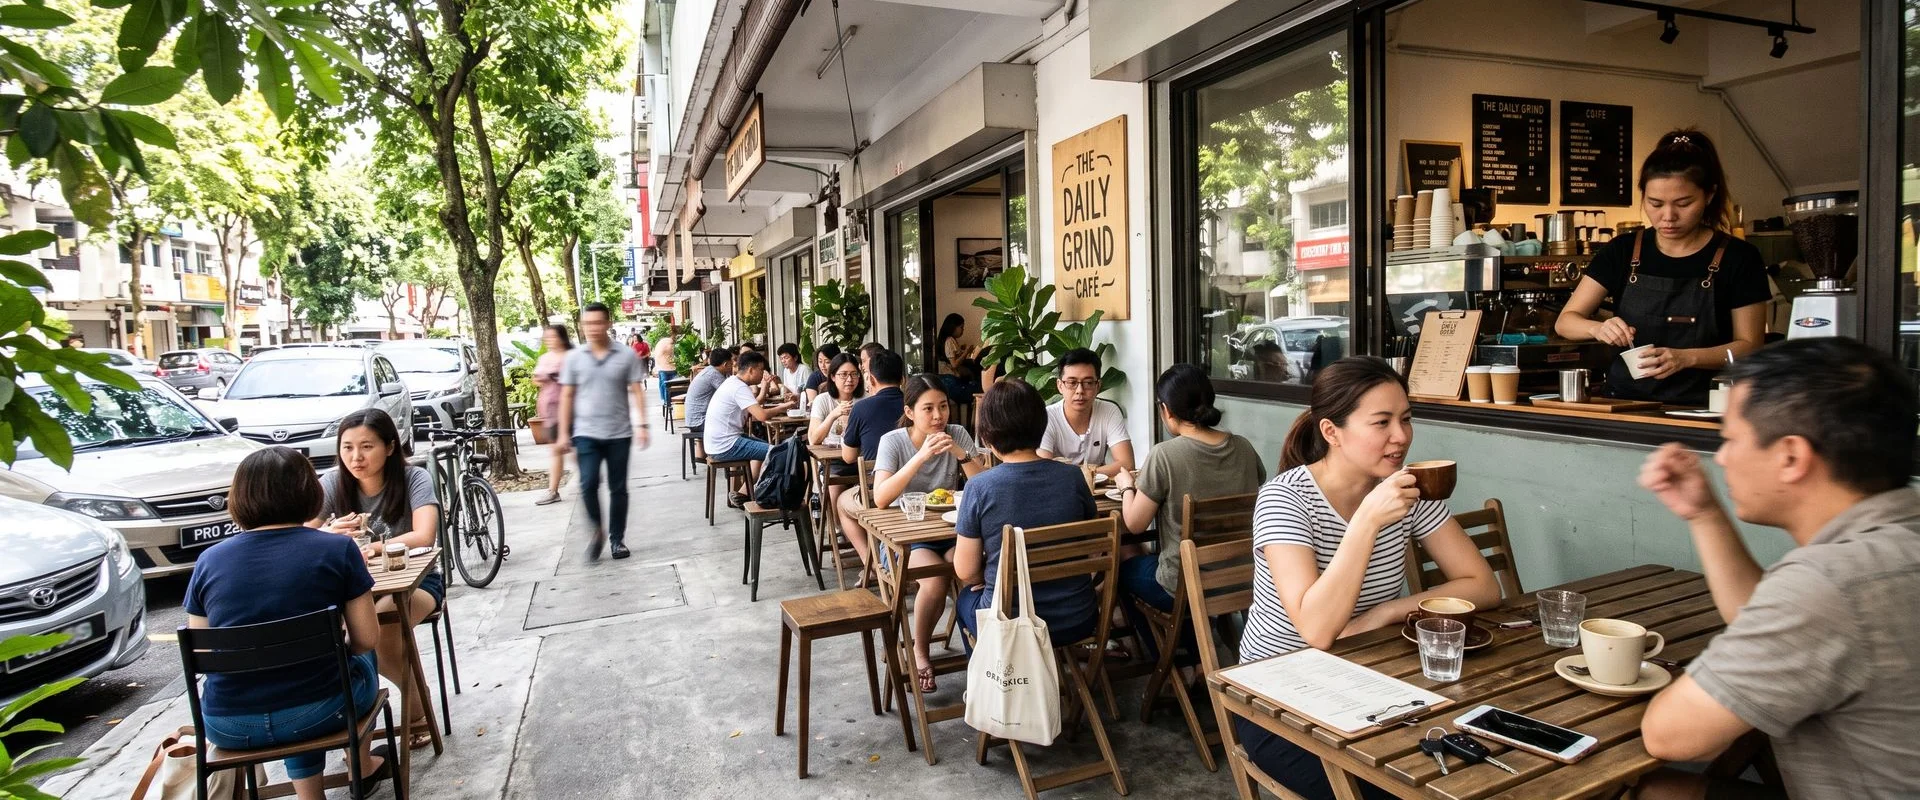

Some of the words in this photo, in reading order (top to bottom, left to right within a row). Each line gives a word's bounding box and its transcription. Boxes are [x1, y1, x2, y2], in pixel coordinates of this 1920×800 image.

[1482, 101, 1496, 112] THE
[1498, 102, 1519, 113] DAILY
[1521, 104, 1544, 115] GRIND
[1076, 149, 1095, 175] THE
[1063, 174, 1110, 226] DAILY
[1062, 225, 1114, 271] GRIND
[1076, 270, 1100, 298] CAFÉ
[194, 525, 220, 541] PRO
[223, 522, 244, 536] 22
